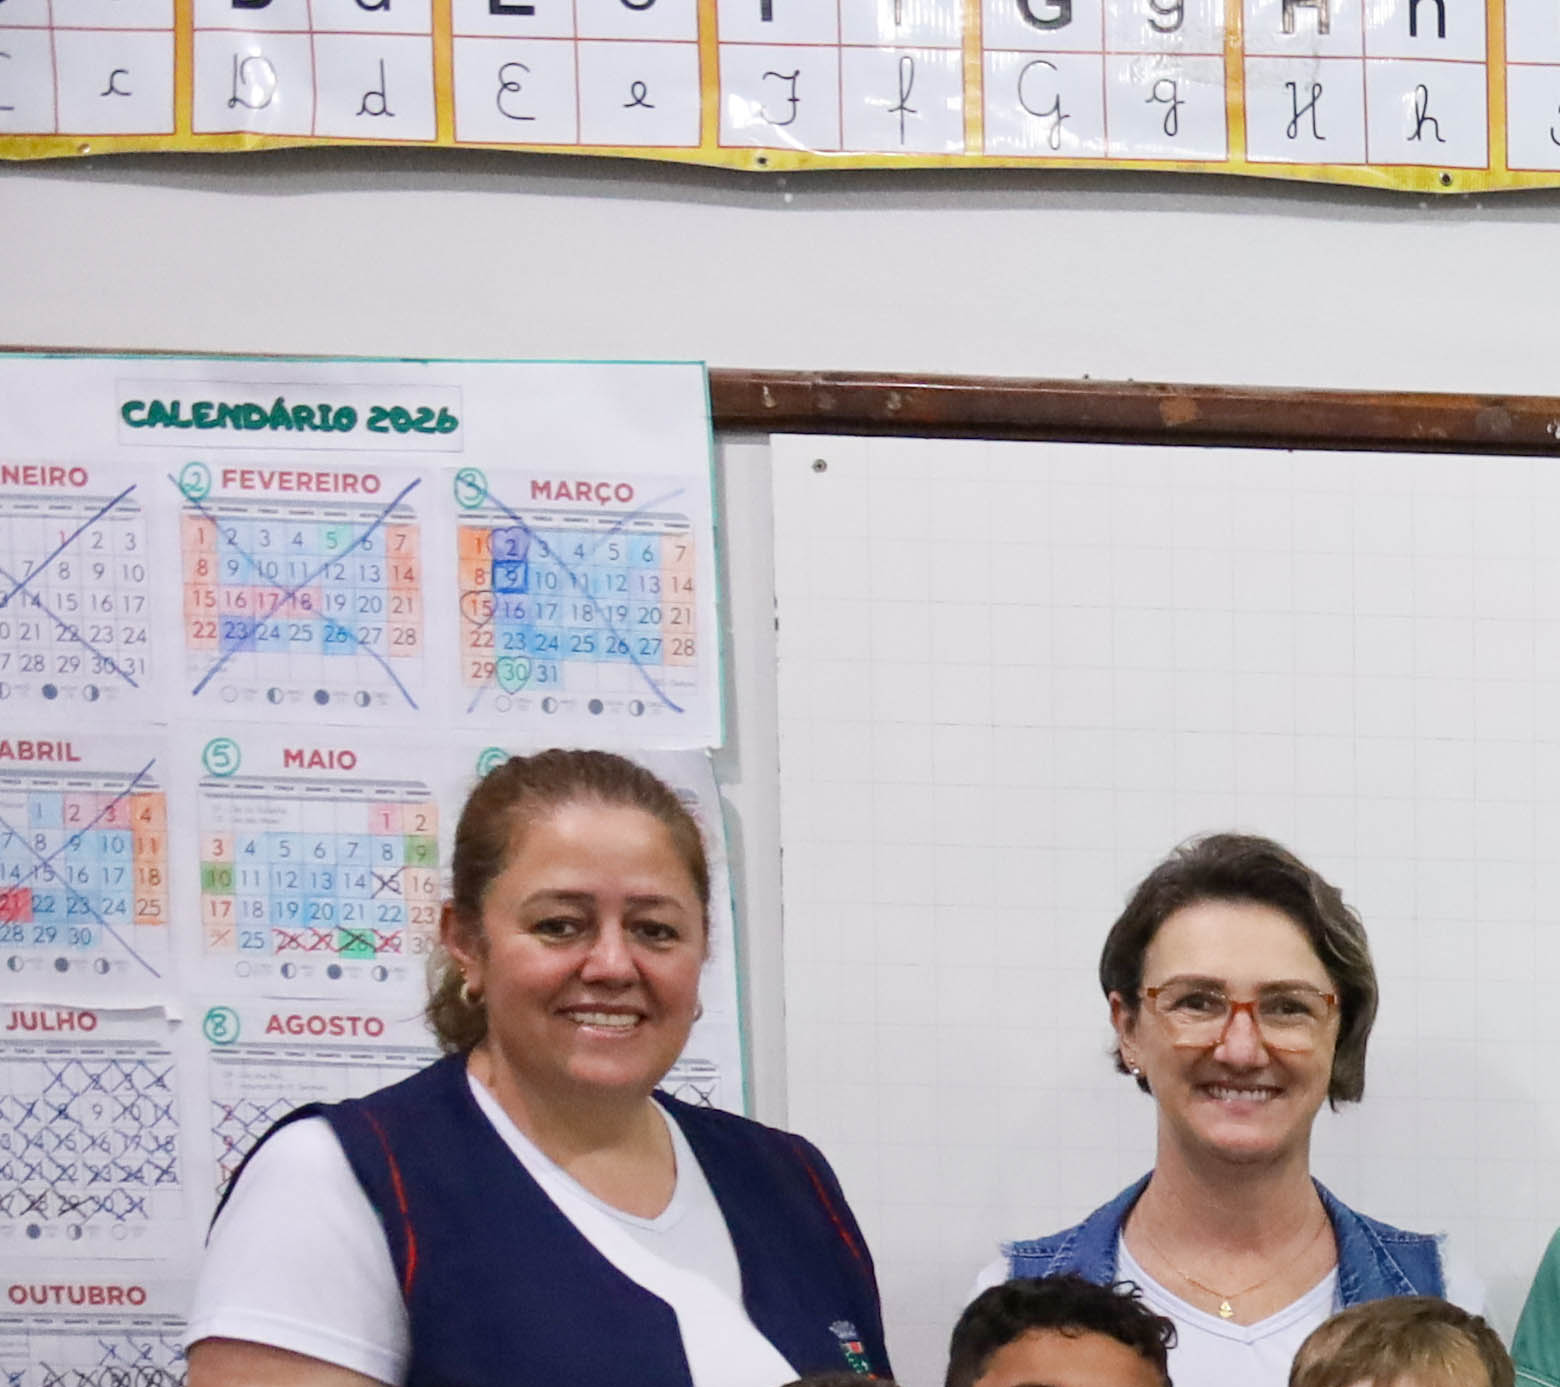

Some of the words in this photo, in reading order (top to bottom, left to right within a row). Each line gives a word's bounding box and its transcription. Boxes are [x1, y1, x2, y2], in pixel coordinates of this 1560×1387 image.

[121, 397, 357, 432] CALENDÁRIO
[366, 405, 459, 434] 2026
[221, 468, 381, 495] FEVEREIRO
[530, 479, 635, 509] MARÇO
[282, 748, 357, 771] MAIO
[5, 1010, 98, 1033] JULHO
[265, 1014, 385, 1037] AGOSTO
[7, 1284, 147, 1306] OUTUBRO
